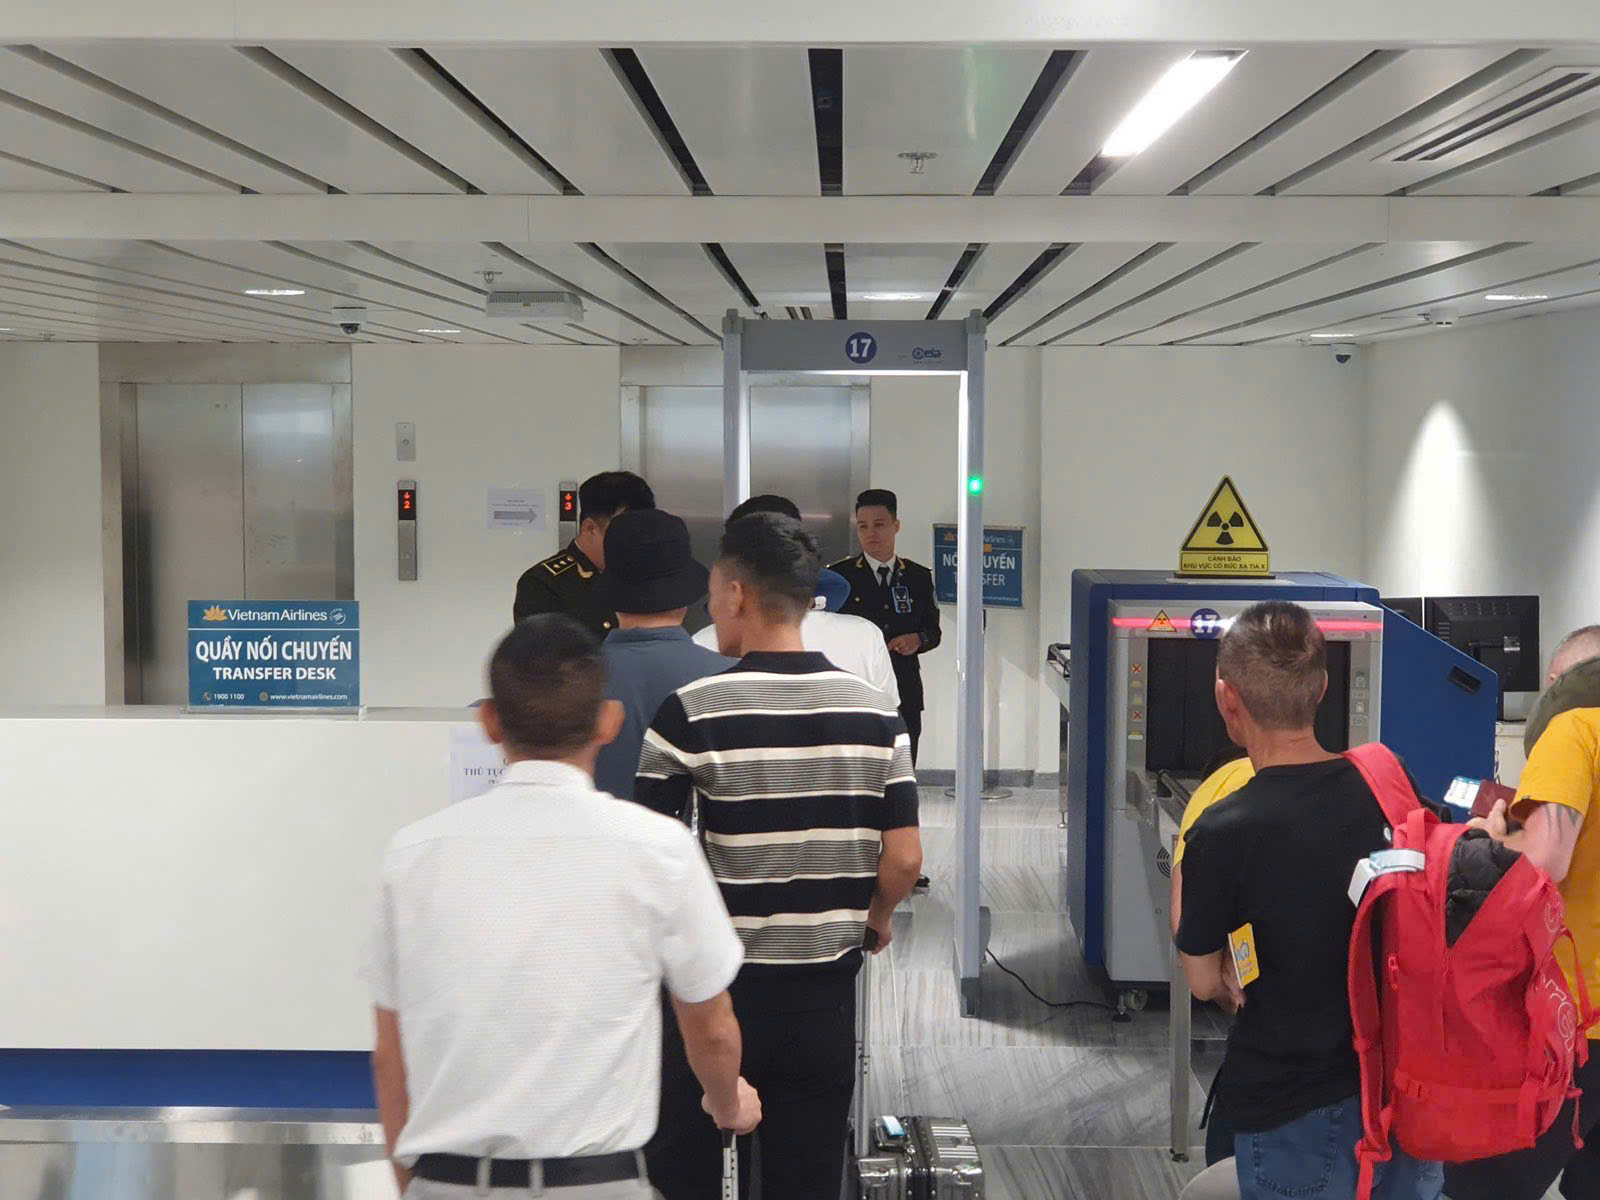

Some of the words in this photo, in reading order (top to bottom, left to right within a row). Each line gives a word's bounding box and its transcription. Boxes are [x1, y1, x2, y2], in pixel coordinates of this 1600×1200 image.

[850, 338, 872, 358] 17
[403, 500, 411, 509] 2
[564, 501, 572, 511] 3
[983, 552, 1016, 570] UYẾN
[227, 608, 280, 621] Vietnam
[280, 608, 328, 621] Airlines
[1194, 614, 1217, 633] 17
[195, 634, 243, 662] QUẦY
[246, 634, 278, 661] NỐI
[281, 634, 352, 661] CHUYẾN
[213, 667, 292, 680] TRANSFER
[296, 667, 336, 680] DESK
[270, 692, 348, 701] www.vietnamairlines.com
